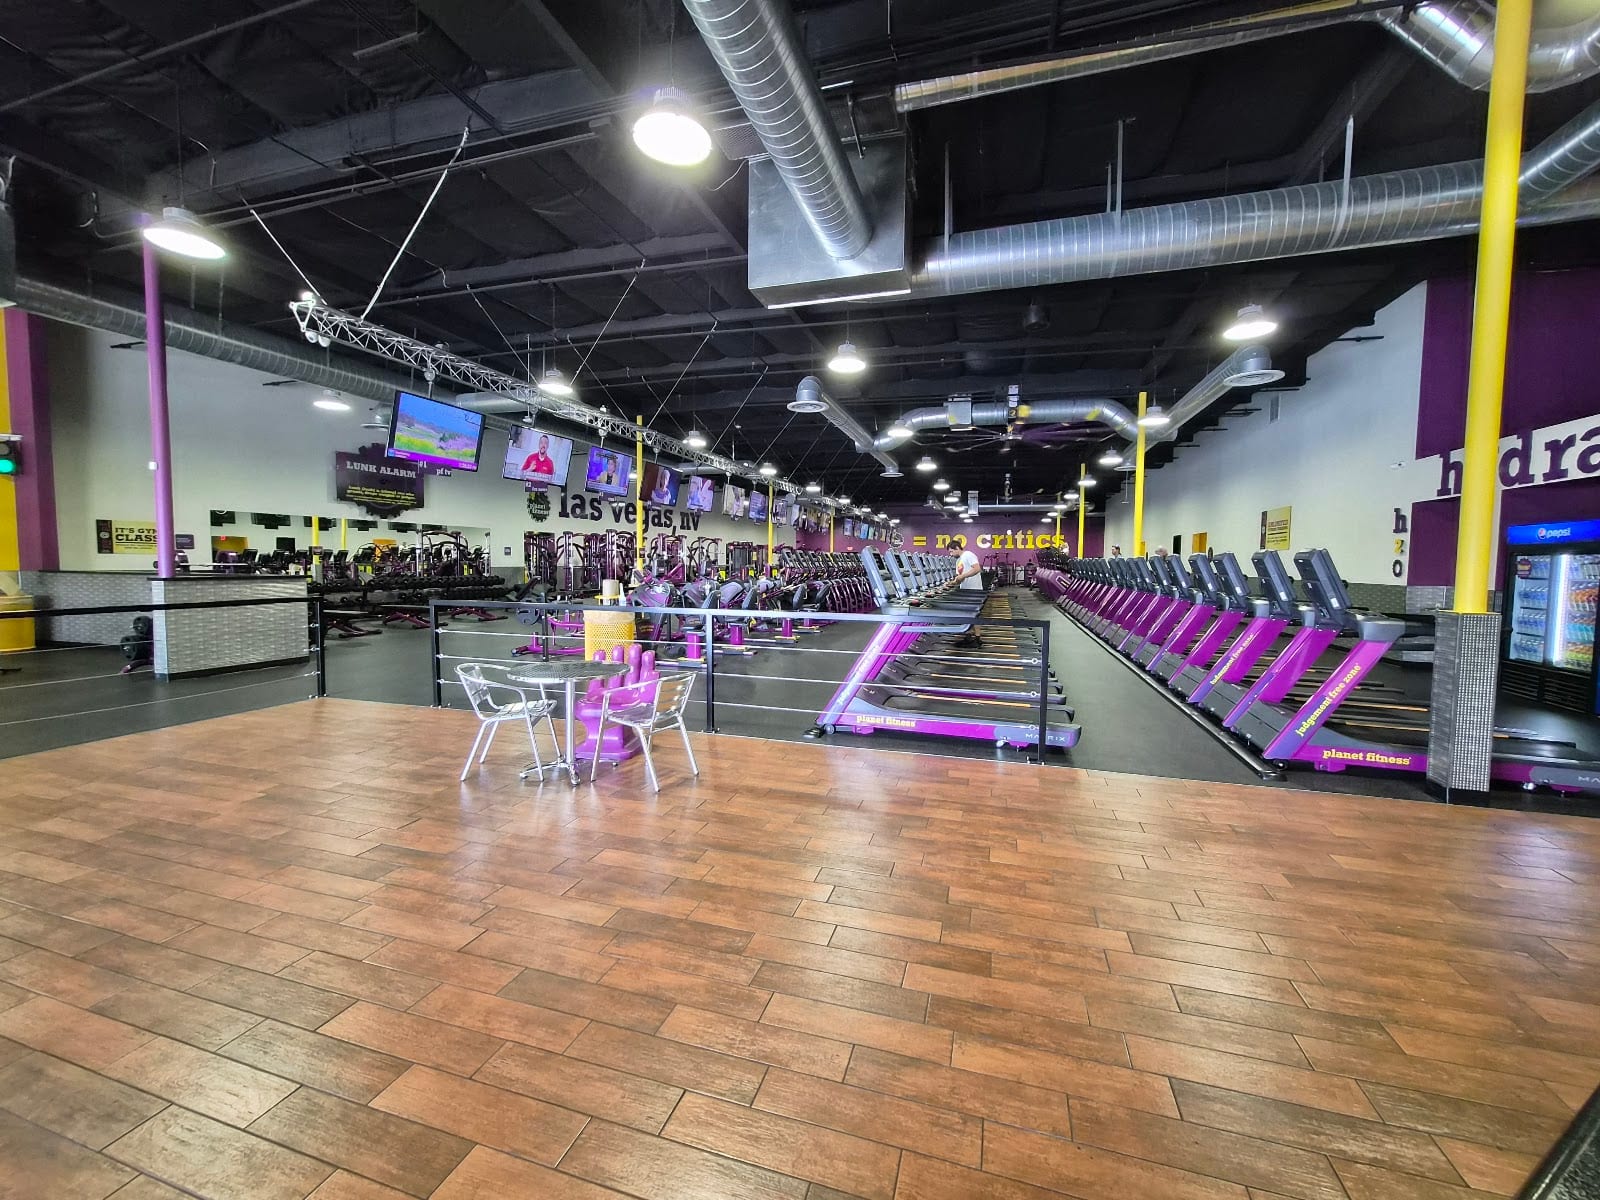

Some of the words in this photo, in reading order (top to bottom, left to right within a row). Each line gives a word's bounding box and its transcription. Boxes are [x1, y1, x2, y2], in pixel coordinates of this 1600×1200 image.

[346, 460, 377, 473] LUNK
[379, 466, 416, 479] ALARM
[1437, 426, 1600, 497] hdra
[558, 484, 603, 521] las
[679, 510, 702, 531] nv
[936, 533, 968, 549] no
[976, 529, 1066, 549] critics
[1547, 527, 1572, 539] pepsi
[1295, 696, 1332, 737] judgement
[1328, 682, 1346, 700] free
[1343, 665, 1362, 684] zone
[856, 715, 884, 725] planet
[885, 717, 917, 728] fitness
[1025, 733, 1066, 742] MARIX
[1322, 748, 1364, 760] planet
[1365, 752, 1410, 765] fitness
